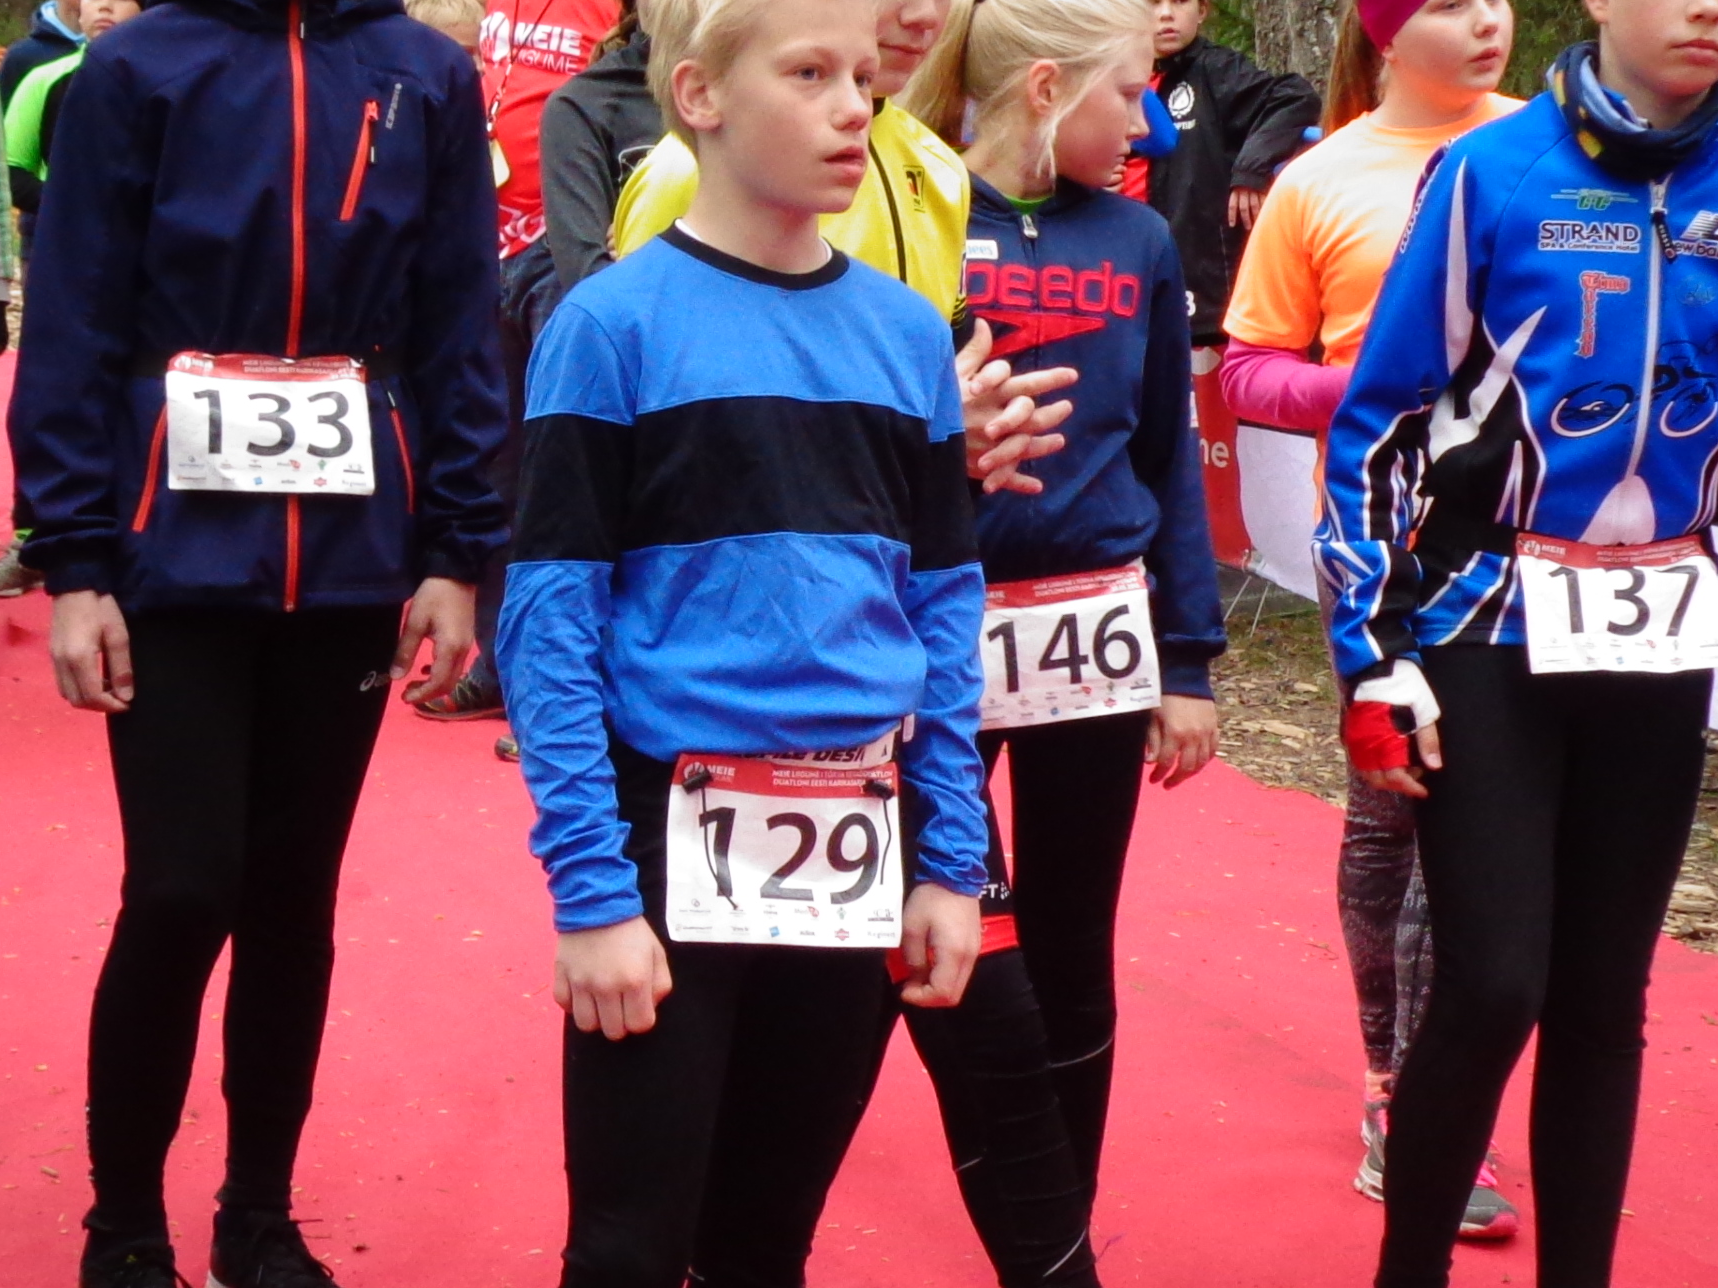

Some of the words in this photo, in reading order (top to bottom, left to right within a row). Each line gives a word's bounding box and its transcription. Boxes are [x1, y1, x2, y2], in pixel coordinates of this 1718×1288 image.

[514, 22, 582, 57] MEIE
[1540, 221, 1640, 243] STRAND
[1674, 241, 1694, 255] ew
[193, 389, 354, 458] 133
[1548, 565, 1701, 637] 137
[987, 604, 1142, 693] 146
[698, 806, 880, 905] 129
